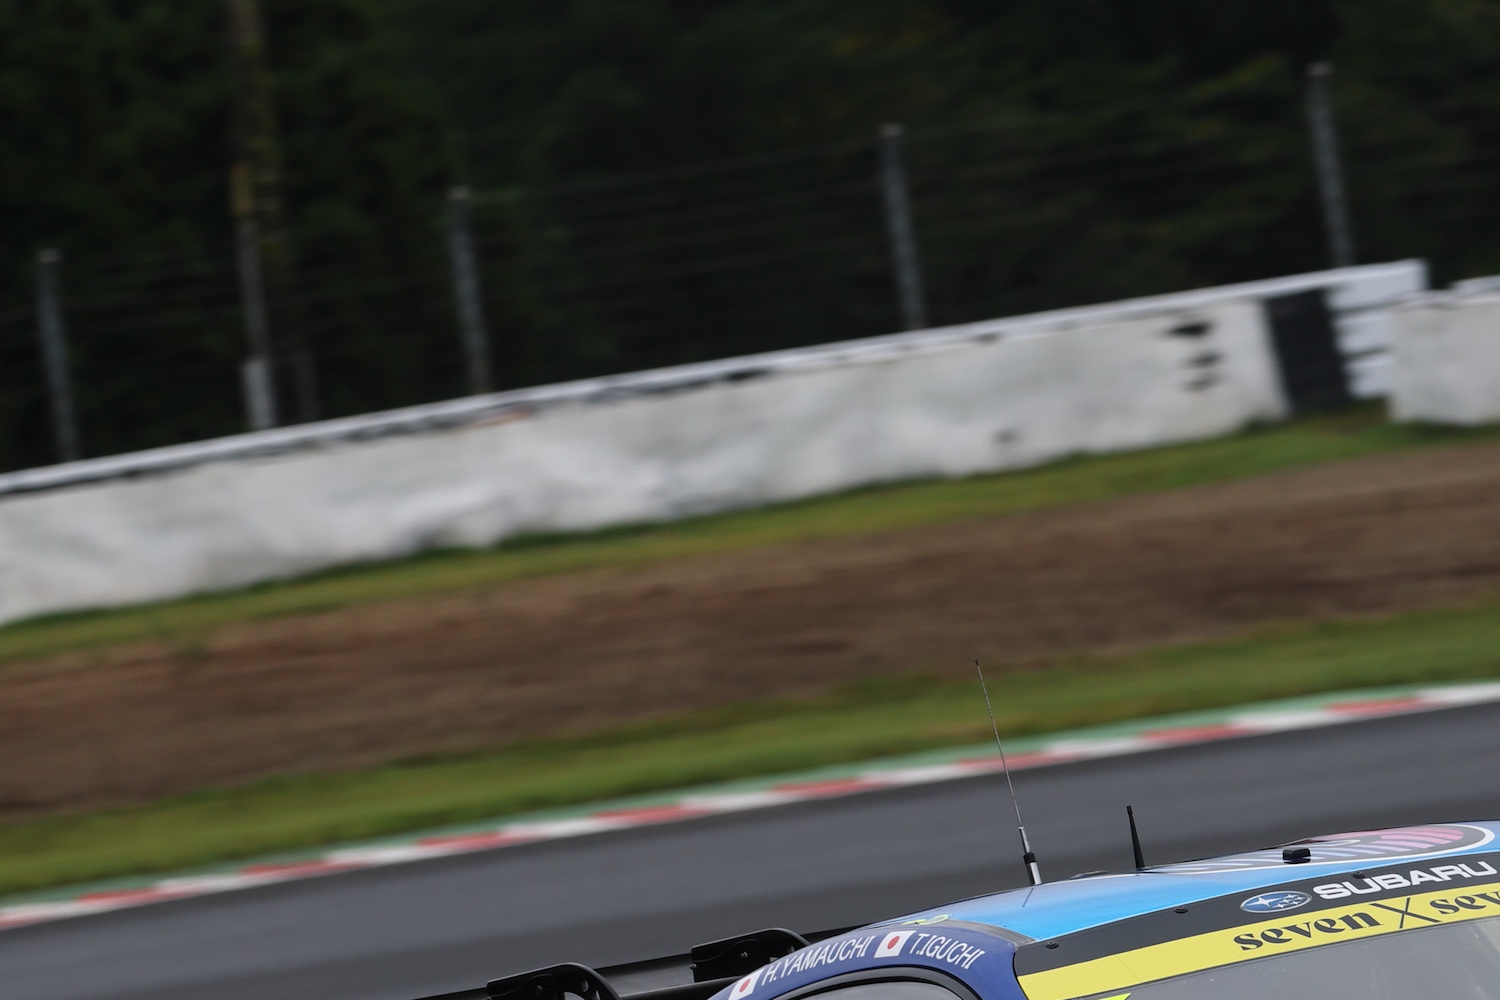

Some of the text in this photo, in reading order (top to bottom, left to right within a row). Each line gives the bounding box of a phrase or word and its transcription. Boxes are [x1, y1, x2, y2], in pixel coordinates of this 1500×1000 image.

[1312, 861, 1498, 900] SUBARU
[908, 932, 986, 970] T.IGUCHI
[1233, 911, 1384, 952] seven
[761, 935, 876, 986] H.YAMAUCHI
